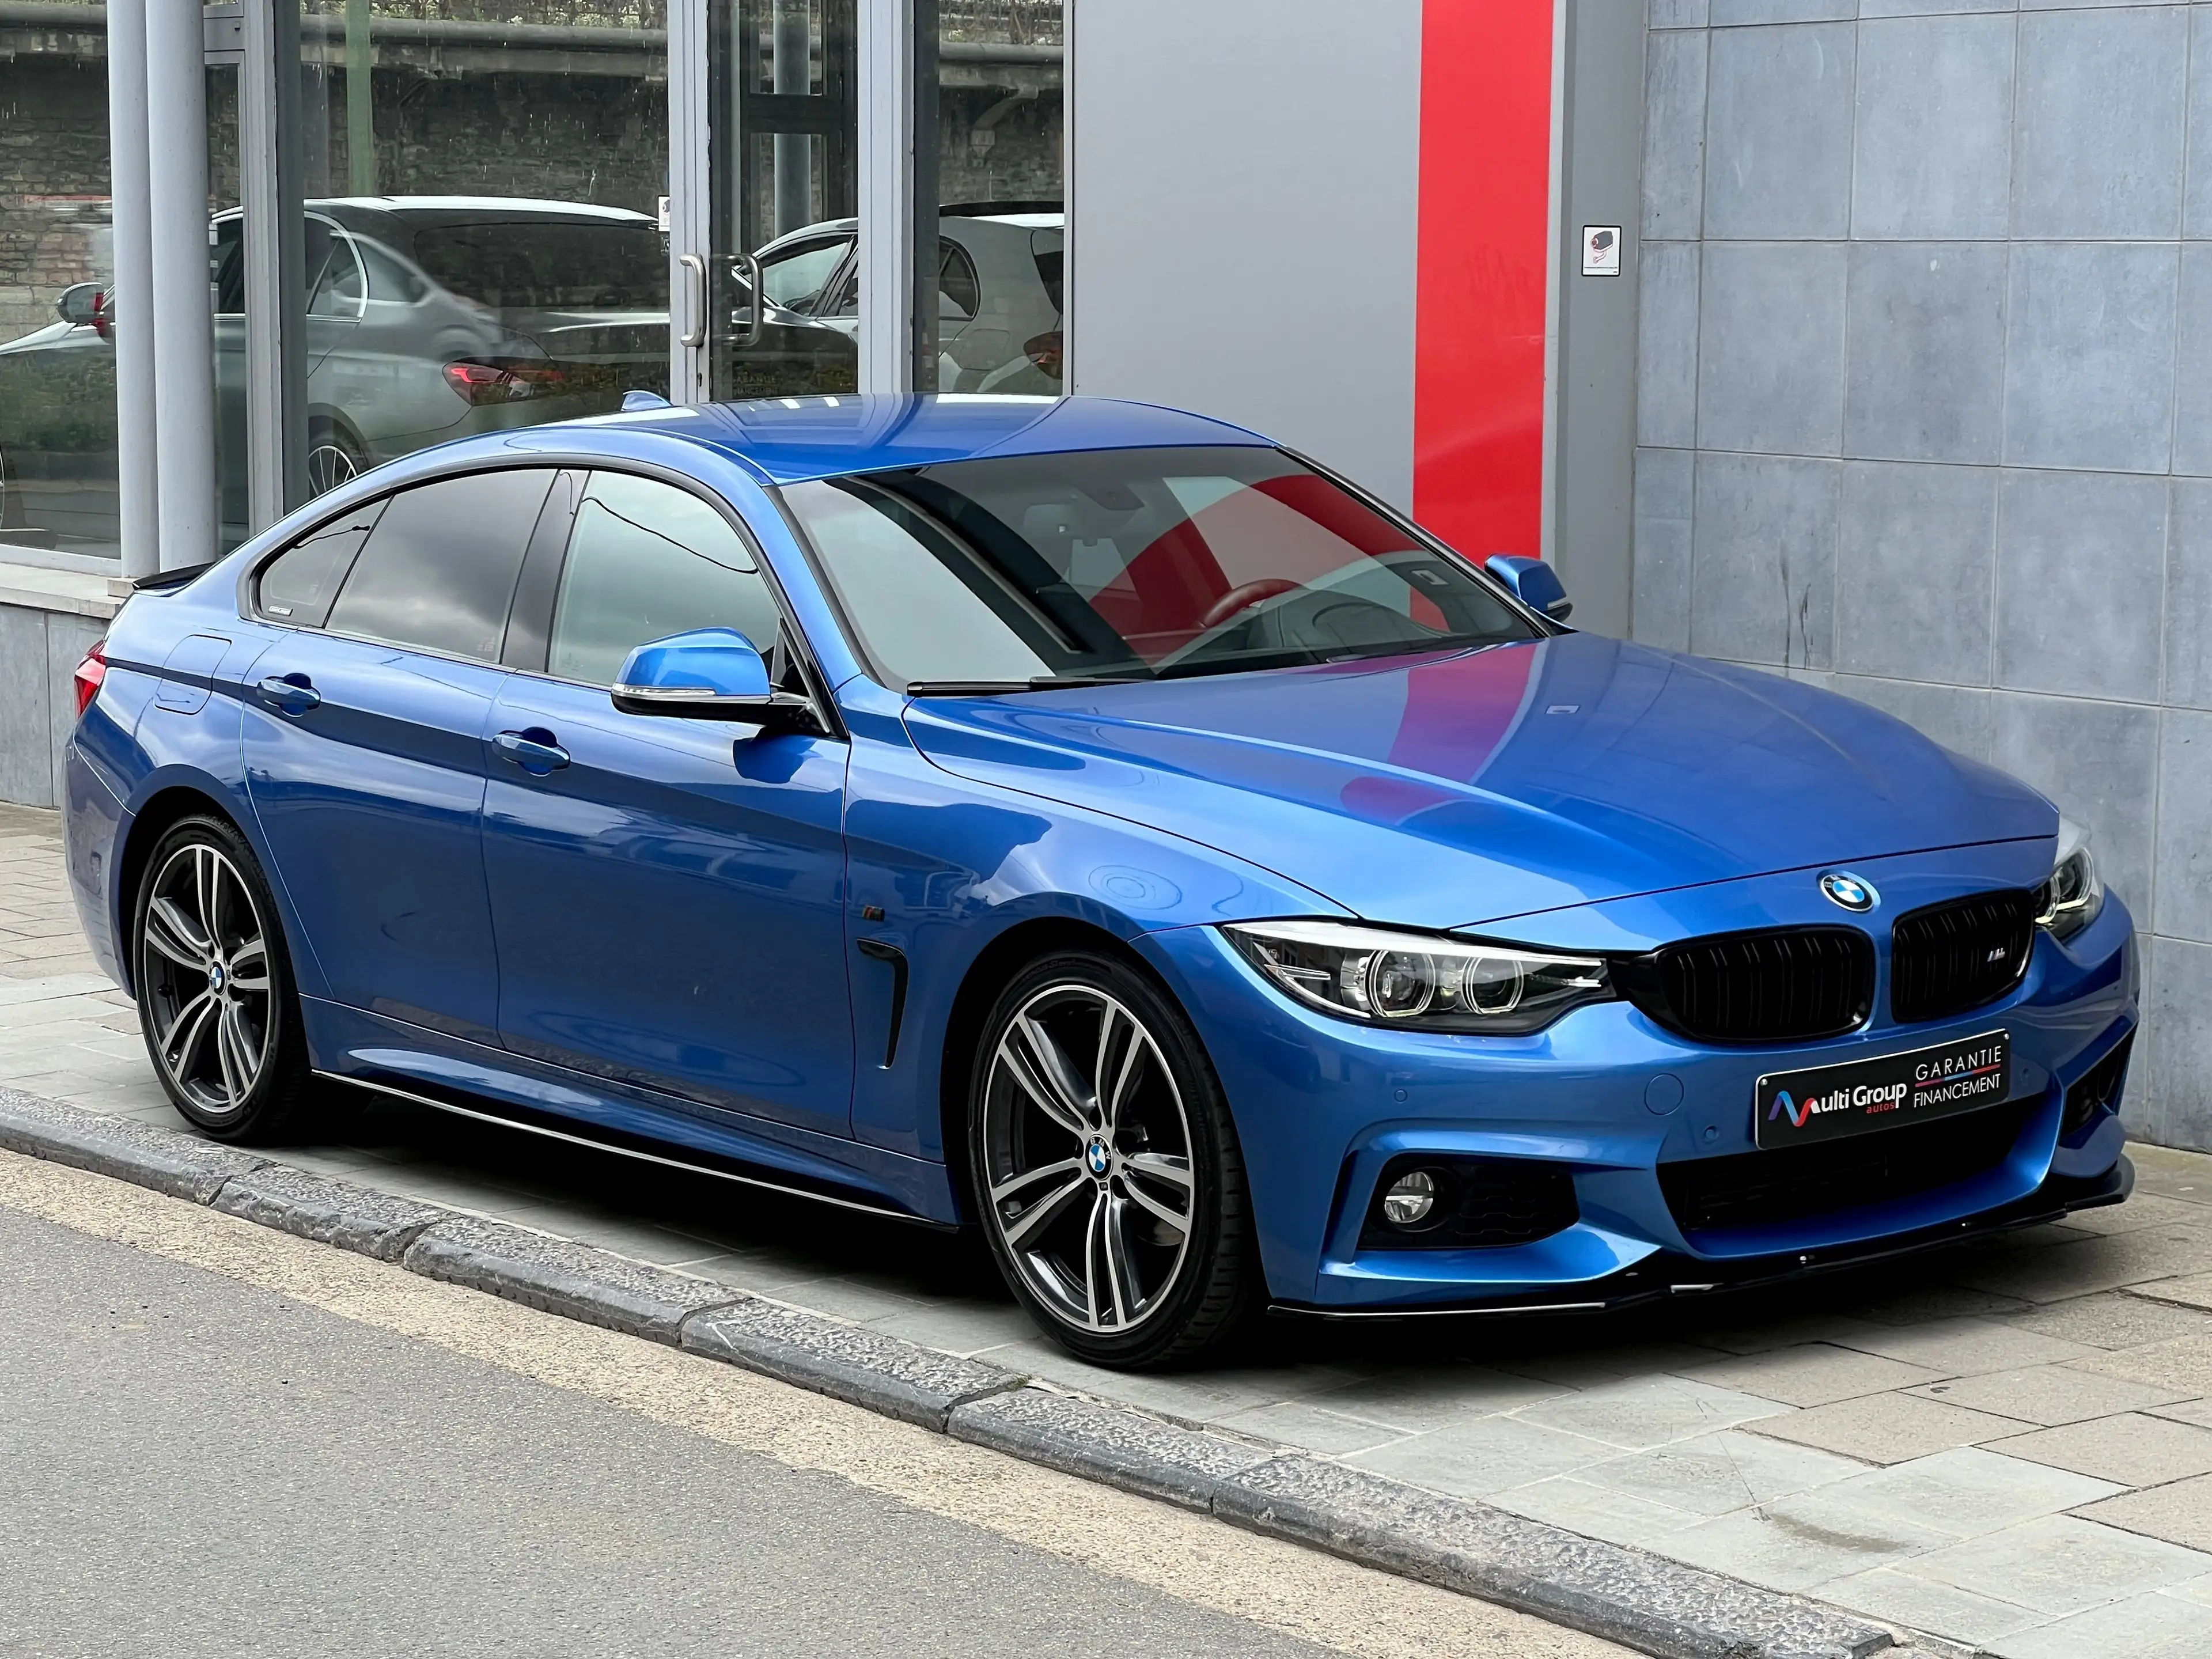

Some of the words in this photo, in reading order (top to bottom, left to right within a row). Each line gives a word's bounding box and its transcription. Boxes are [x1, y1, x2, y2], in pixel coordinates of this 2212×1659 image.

[1915, 1046, 2001, 1081] GARANTIE
[1853, 1083, 1907, 1109] Group
[1914, 1073, 2001, 1108] FINANCEMENT
[1866, 1101, 1895, 1114] autos
[1090, 1137, 1111, 1160] BMW
